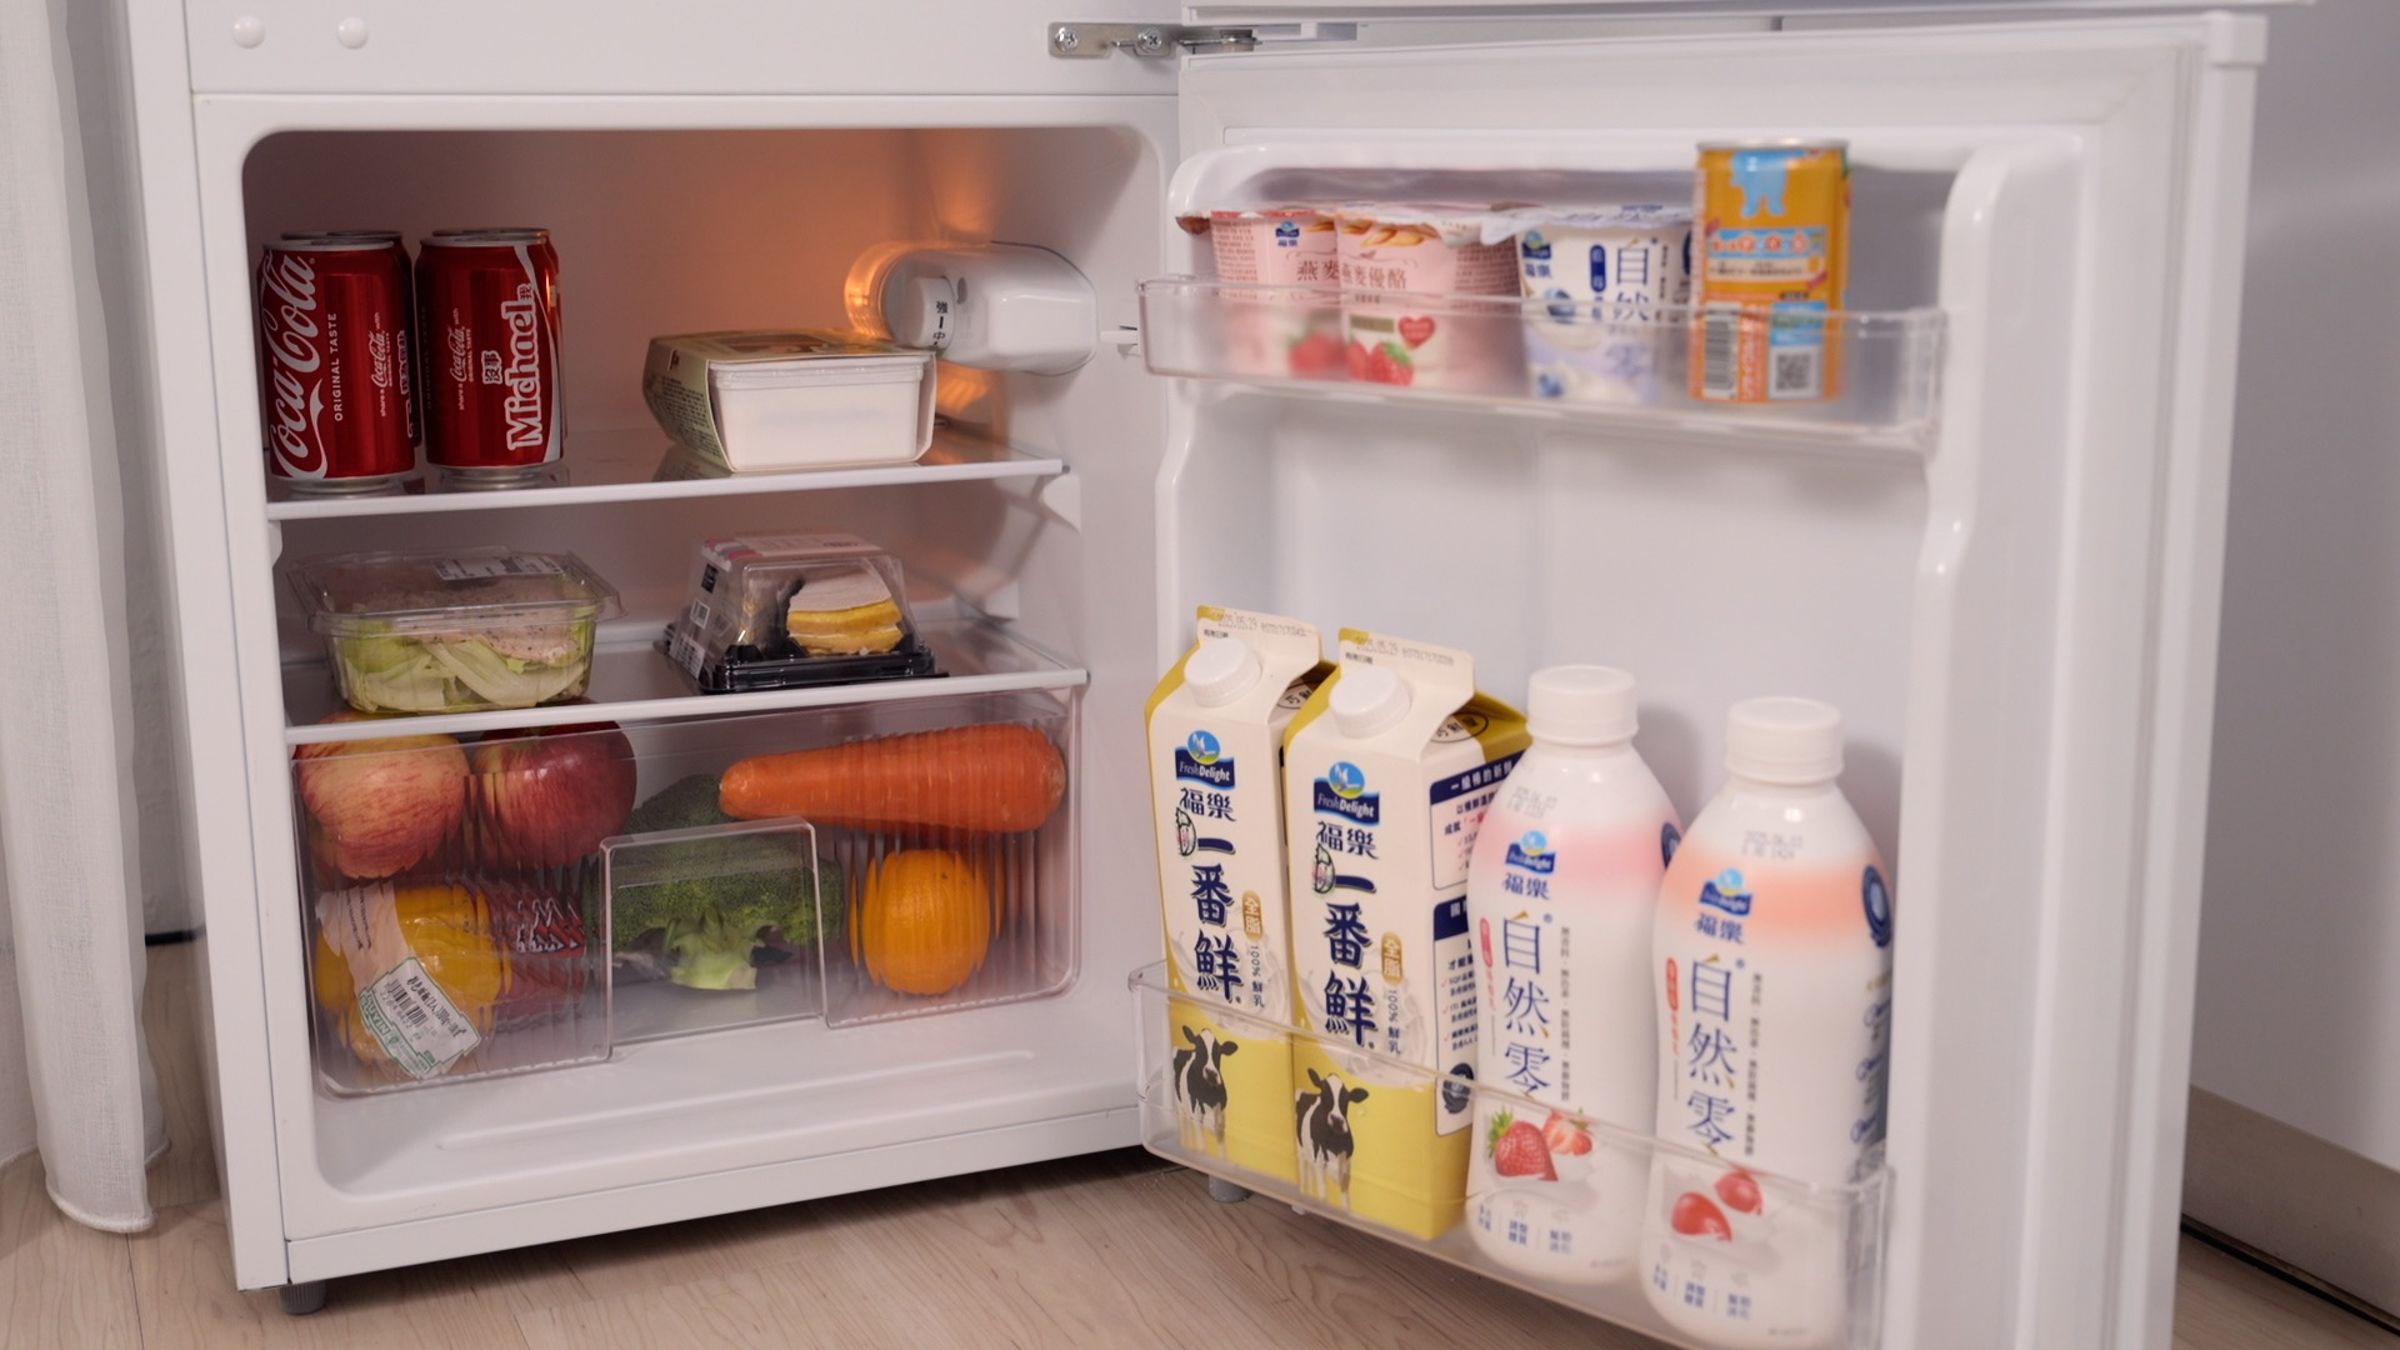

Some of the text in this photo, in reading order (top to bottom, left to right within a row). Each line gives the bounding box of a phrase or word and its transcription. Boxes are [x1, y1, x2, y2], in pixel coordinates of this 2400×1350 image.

[260, 250, 328, 479] Coca-Cola
[328, 312, 344, 421] ORIGINAL TASTE
[369, 330, 389, 387] Coca-Cola
[448, 326, 467, 382] Coca-Cola
[482, 351, 502, 384] 沒事
[501, 300, 543, 450] Michael
[1179, 760, 1231, 783] FreshDelight
[1180, 787, 1236, 822] 福樂
[1317, 791, 1375, 818] FreshDelight
[1316, 821, 1379, 860] 福樂
[1503, 872, 1550, 900] 福樂
[1190, 837, 1244, 1004] 一番鮮
[1696, 912, 1745, 944] 福樂
[1323, 874, 1379, 1048] 一番鮮
[1503, 912, 1550, 1099] 自然零
[1687, 954, 1738, 1155] 自然零
